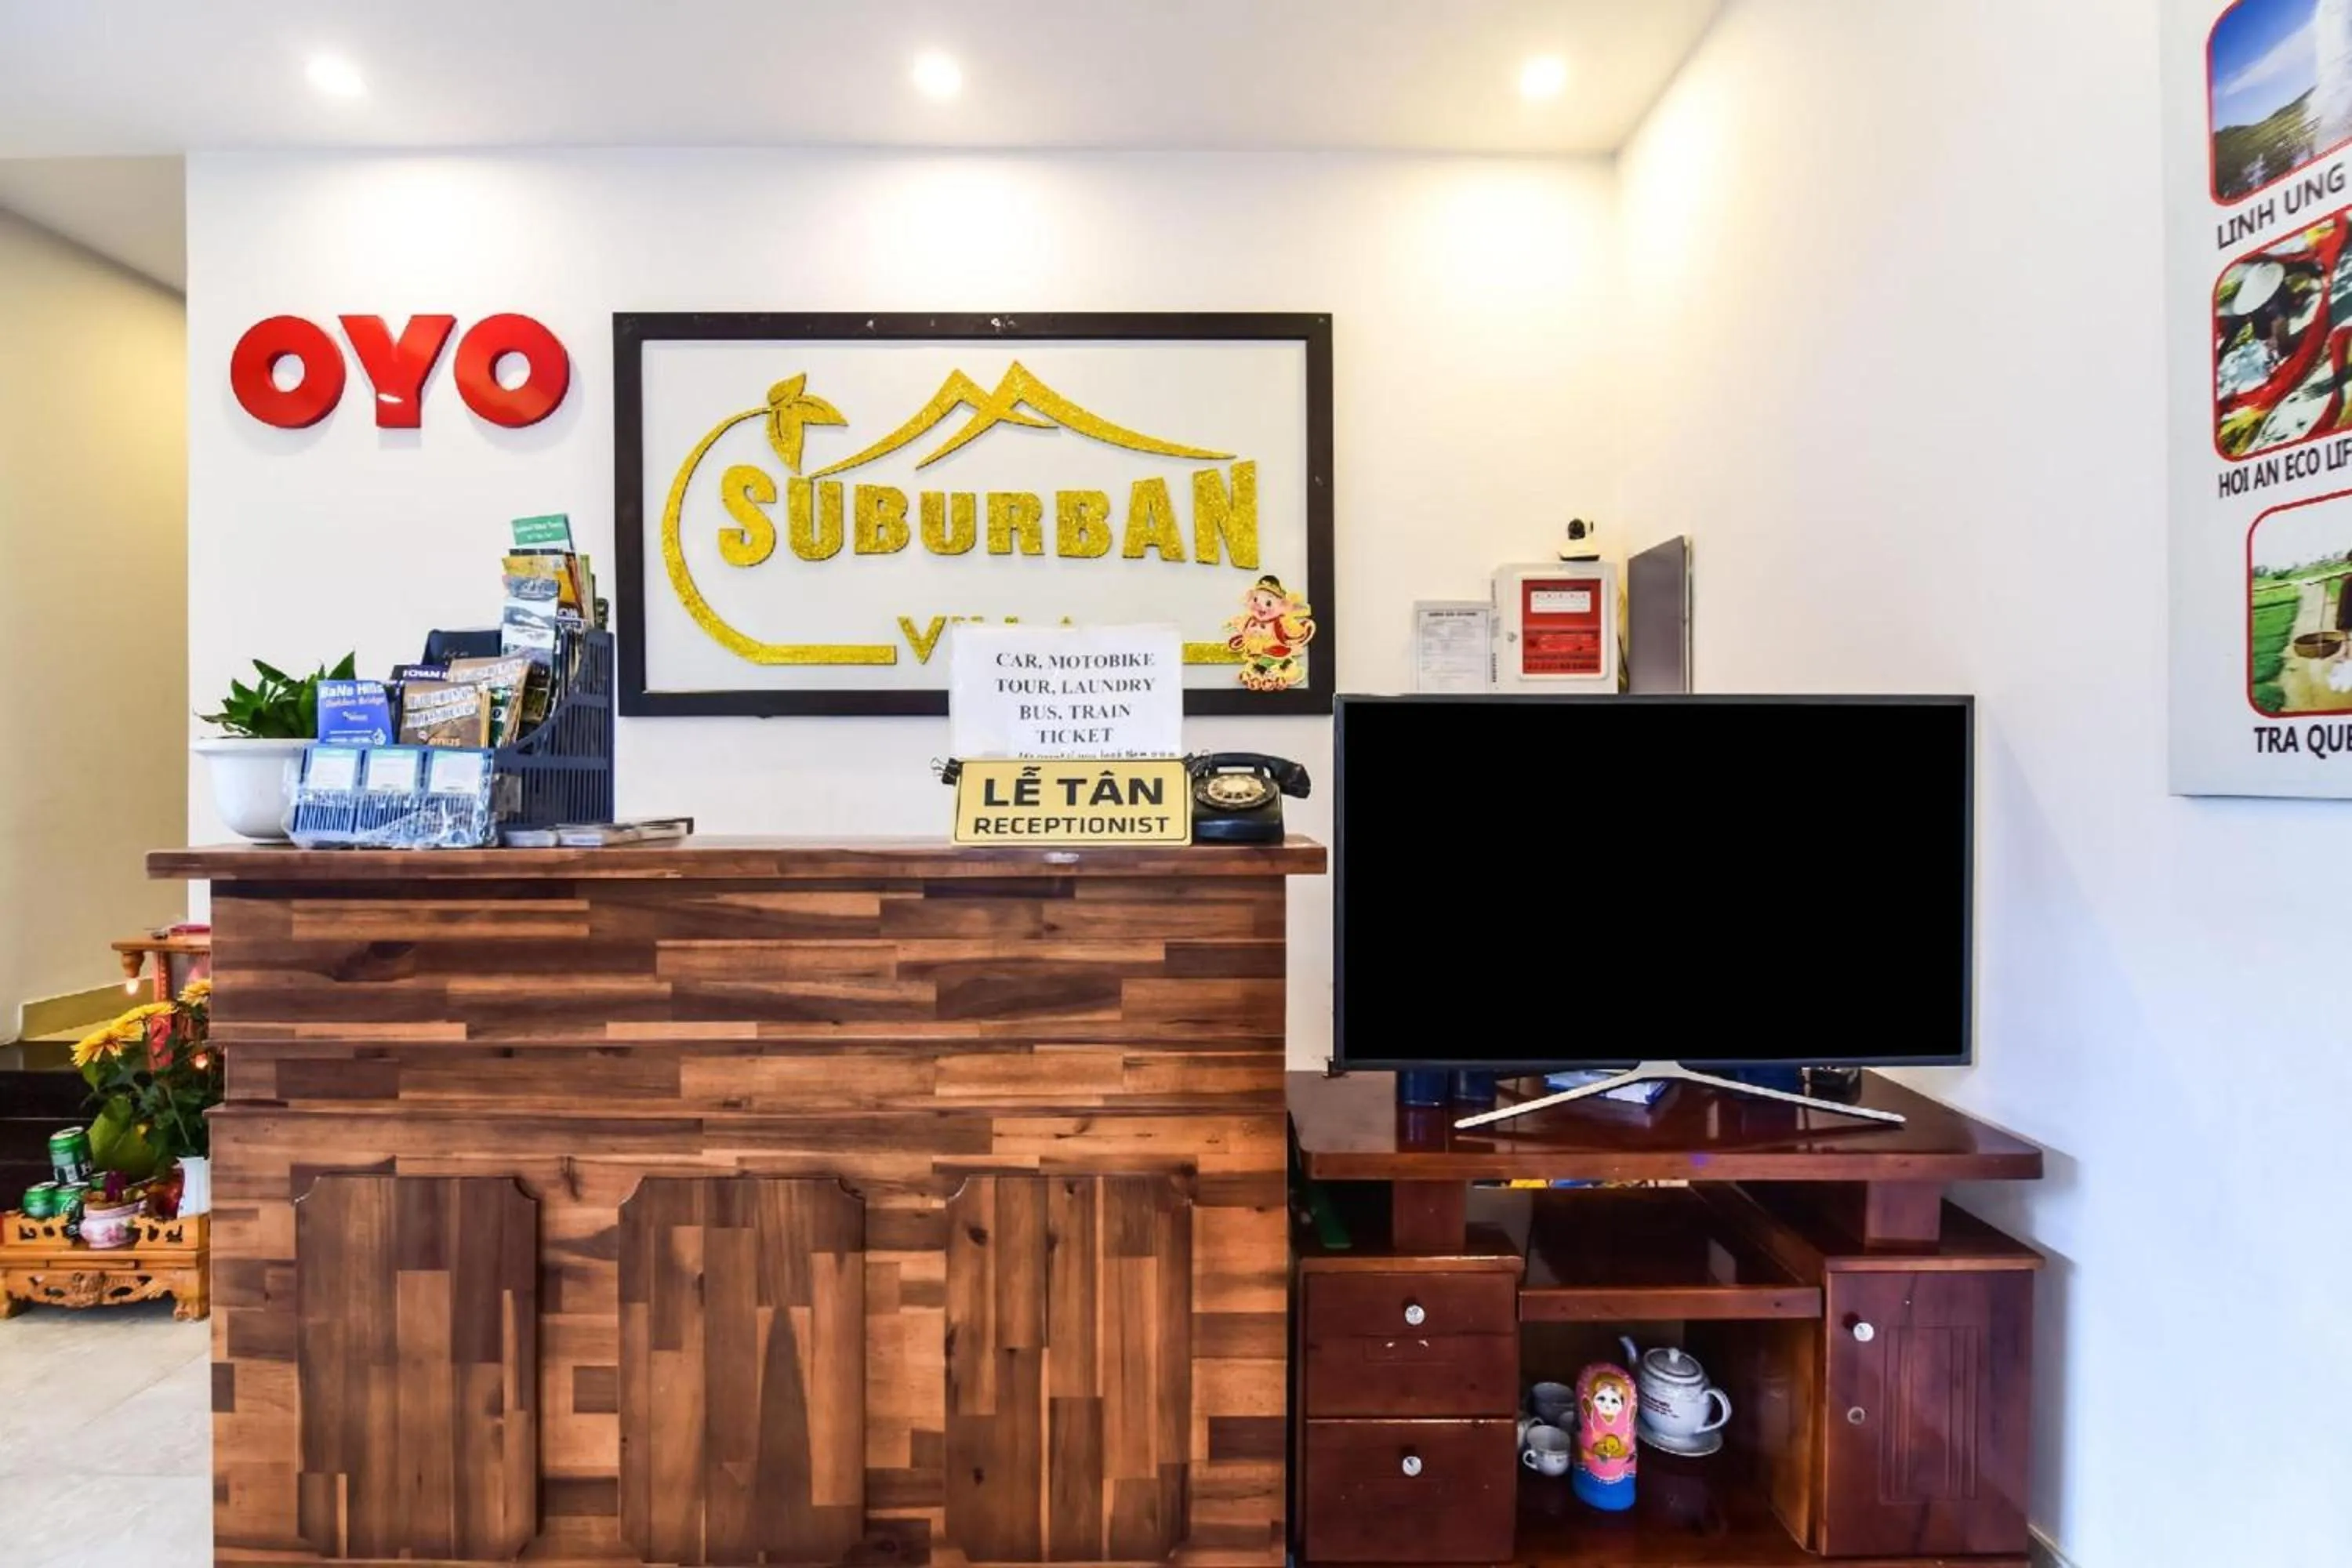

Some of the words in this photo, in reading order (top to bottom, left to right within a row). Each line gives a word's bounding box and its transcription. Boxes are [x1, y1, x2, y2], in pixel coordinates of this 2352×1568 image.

[2217, 198, 2275, 249] LINH
[2284, 162, 2346, 215] UNG
[230, 314, 570, 430] OYO
[2218, 466, 2249, 499] HOI
[2253, 459, 2279, 489] AN
[2285, 448, 2320, 482] ECO
[718, 460, 1260, 569] SUBURBAN
[996, 653, 1043, 669] CAR,
[1048, 652, 1156, 670] MOTOBIKE
[996, 678, 1056, 695] TOUR,
[1061, 677, 1155, 694] LAUNDRY
[1069, 703, 1131, 720] TRAIN
[1036, 728, 1114, 744] TICKET
[2254, 726, 2299, 753] TRA
[984, 766, 1041, 807] LỄ
[1056, 770, 1163, 806] TÂN
[974, 817, 1170, 834] RECEPTIONIST
